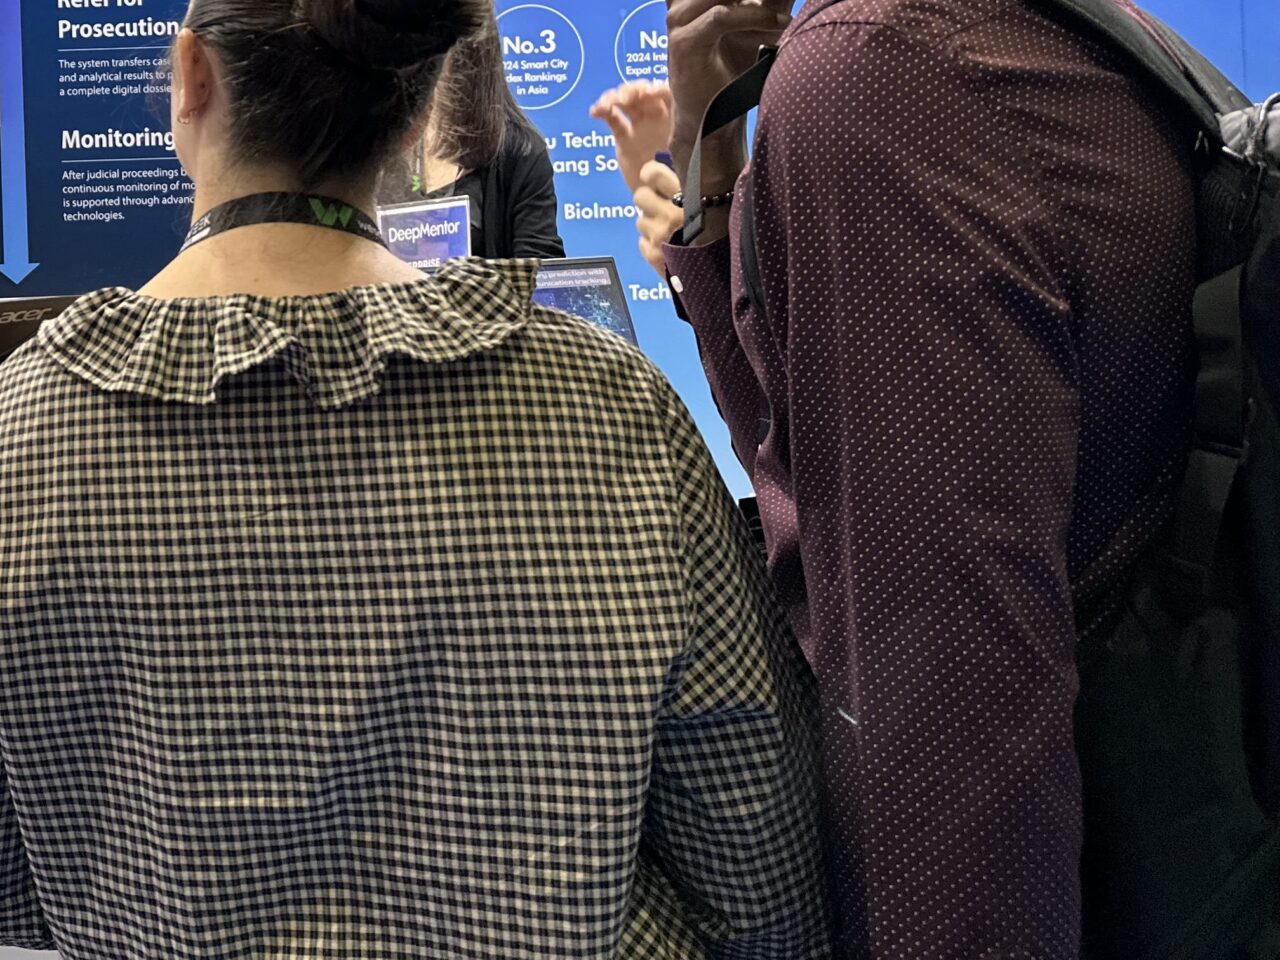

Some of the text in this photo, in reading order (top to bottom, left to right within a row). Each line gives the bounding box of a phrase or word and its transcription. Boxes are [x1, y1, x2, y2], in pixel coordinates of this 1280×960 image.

[58, 18, 179, 38] Prosecution
[503, 30, 556, 55] No.3
[640, 31, 668, 49] No
[59, 56, 169, 70] The system transfers cas
[626, 52, 650, 62] 2024
[521, 58, 568, 71] Smart City
[626, 65, 651, 77] Expat
[59, 72, 76, 82] and
[79, 70, 121, 83] analytical
[124, 70, 153, 80] results
[156, 70, 165, 79] to
[524, 71, 567, 84] Rankings
[68, 84, 110, 97] complete
[112, 83, 141, 96] digital
[143, 83, 172, 94] dossie
[517, 85, 548, 95] in Asia
[62, 127, 176, 150] Monitoring
[562, 131, 615, 149] Techn
[62, 170, 84, 180] After
[87, 168, 120, 180] judicial
[122, 167, 179, 179] proceedings
[63, 179, 179, 194] continuous monitoring of
[63, 193, 194, 209] is supported through advanc
[64, 209, 124, 222] technologies.
[564, 203, 643, 220] BioInnov
[389, 221, 460, 243] DeepMentor
[629, 283, 670, 300] Tech
